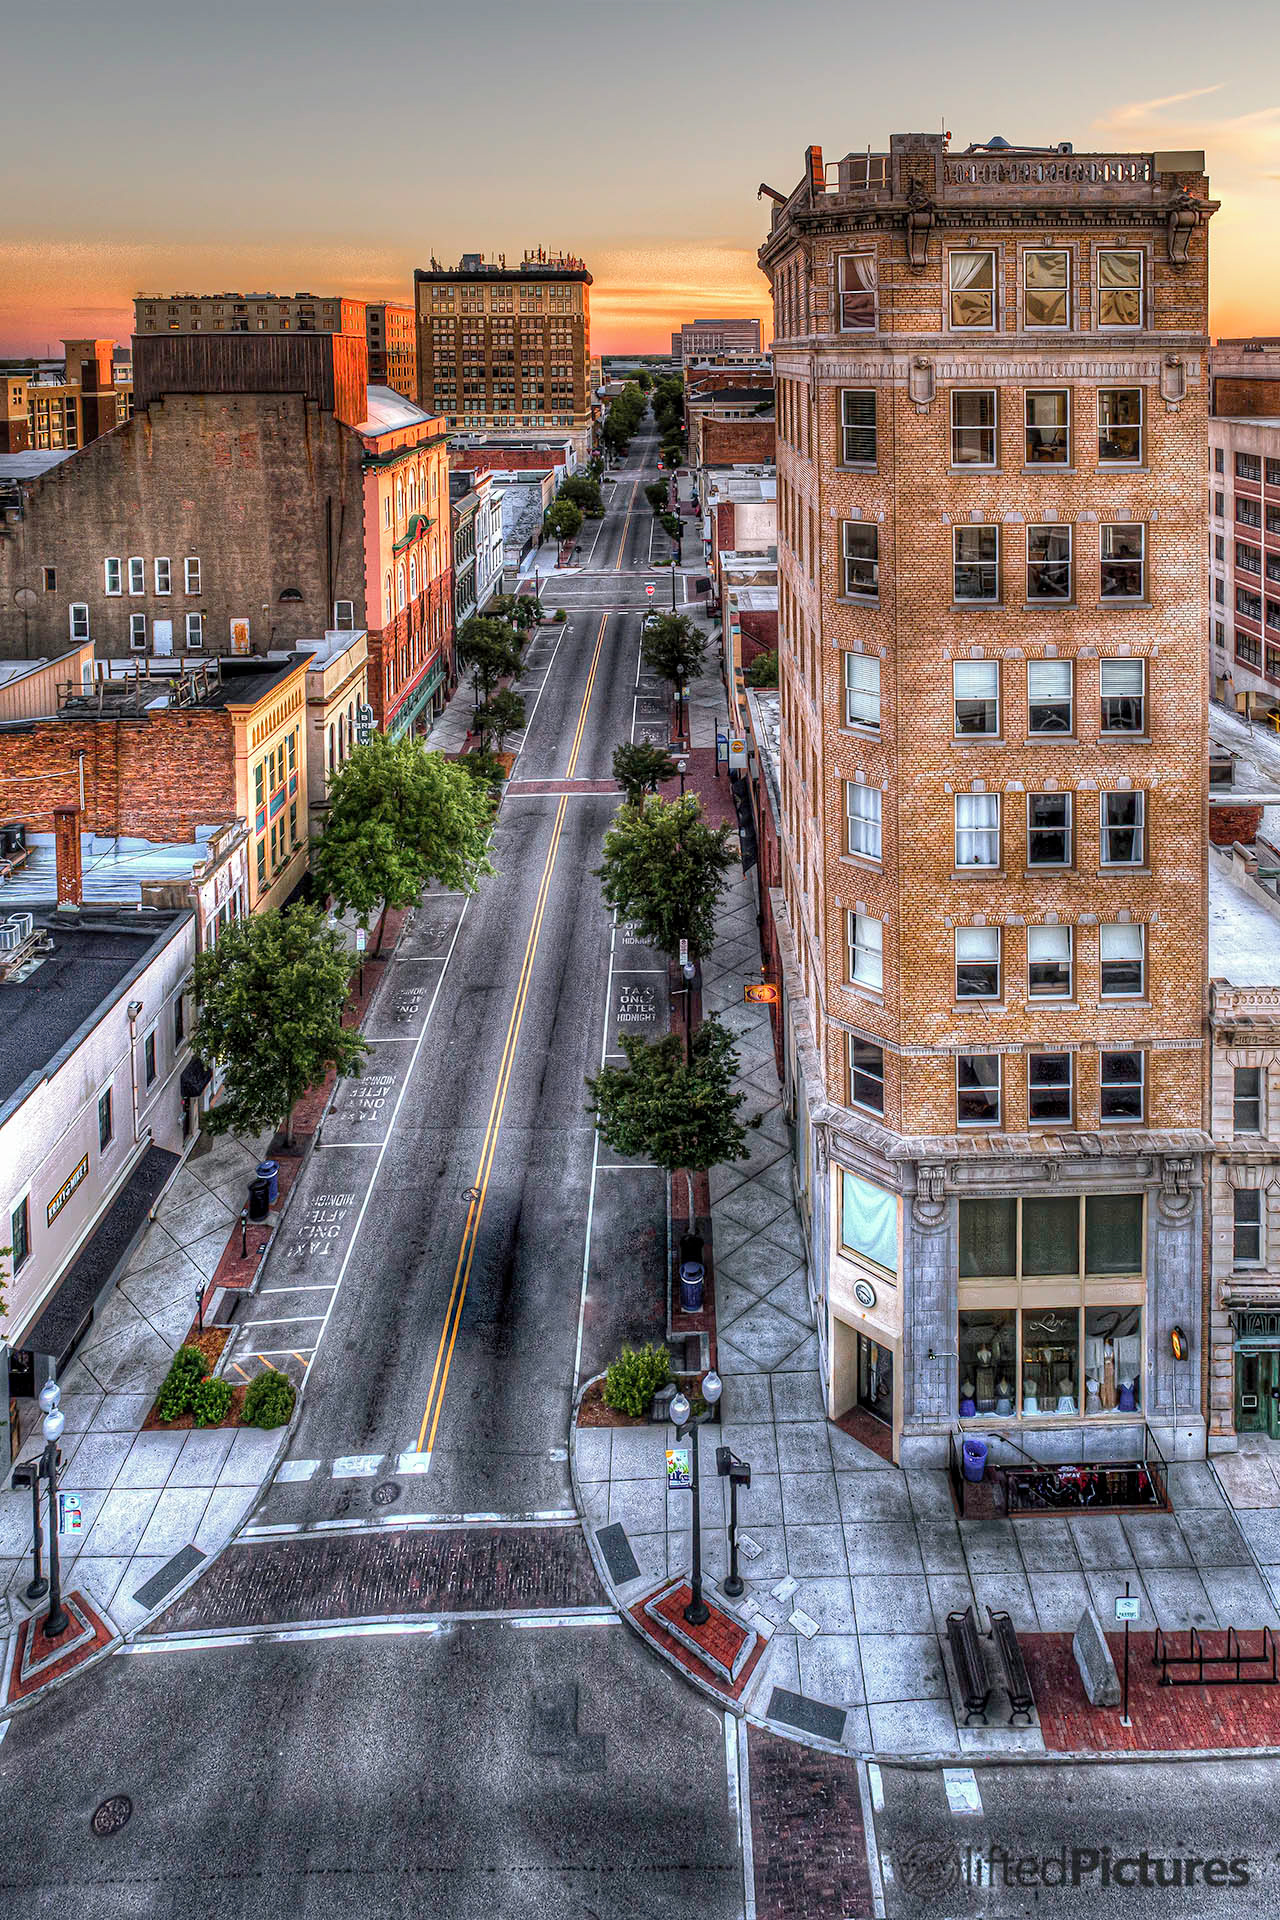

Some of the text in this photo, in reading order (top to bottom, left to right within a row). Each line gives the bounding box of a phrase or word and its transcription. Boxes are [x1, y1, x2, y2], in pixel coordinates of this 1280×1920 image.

[619, 1004, 656, 1013] AFTER
[361, 1075, 397, 1086] MIDNIG
[311, 1193, 356, 1207] MIDNIG
[306, 1208, 348, 1223] AFTE
